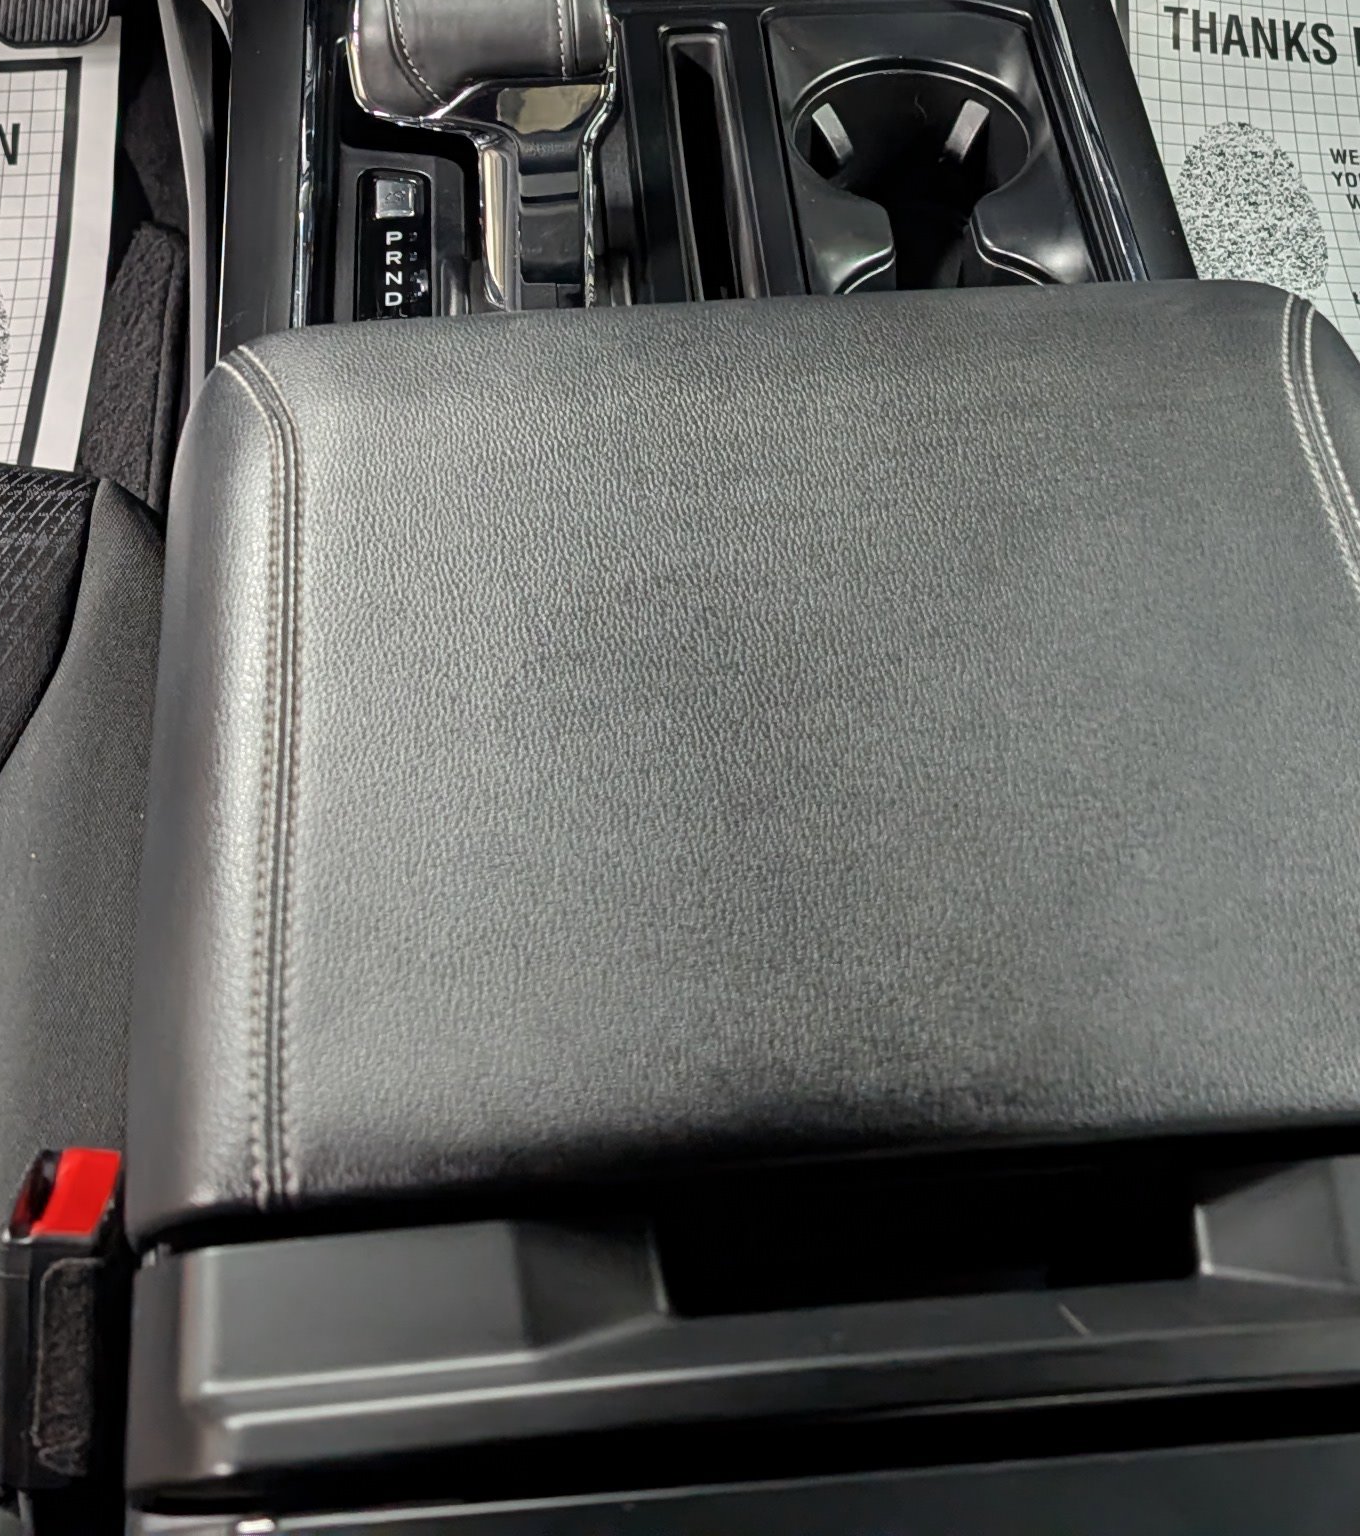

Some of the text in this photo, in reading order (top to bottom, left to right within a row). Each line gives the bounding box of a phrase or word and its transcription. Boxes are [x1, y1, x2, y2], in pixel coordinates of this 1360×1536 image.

[1164, 4, 1338, 67] THANKS
[1329, 148, 1360, 165] WE
[386, 231, 403, 245] P
[386, 251, 403, 265] R
[386, 271, 403, 286] N
[385, 292, 403, 307] D
